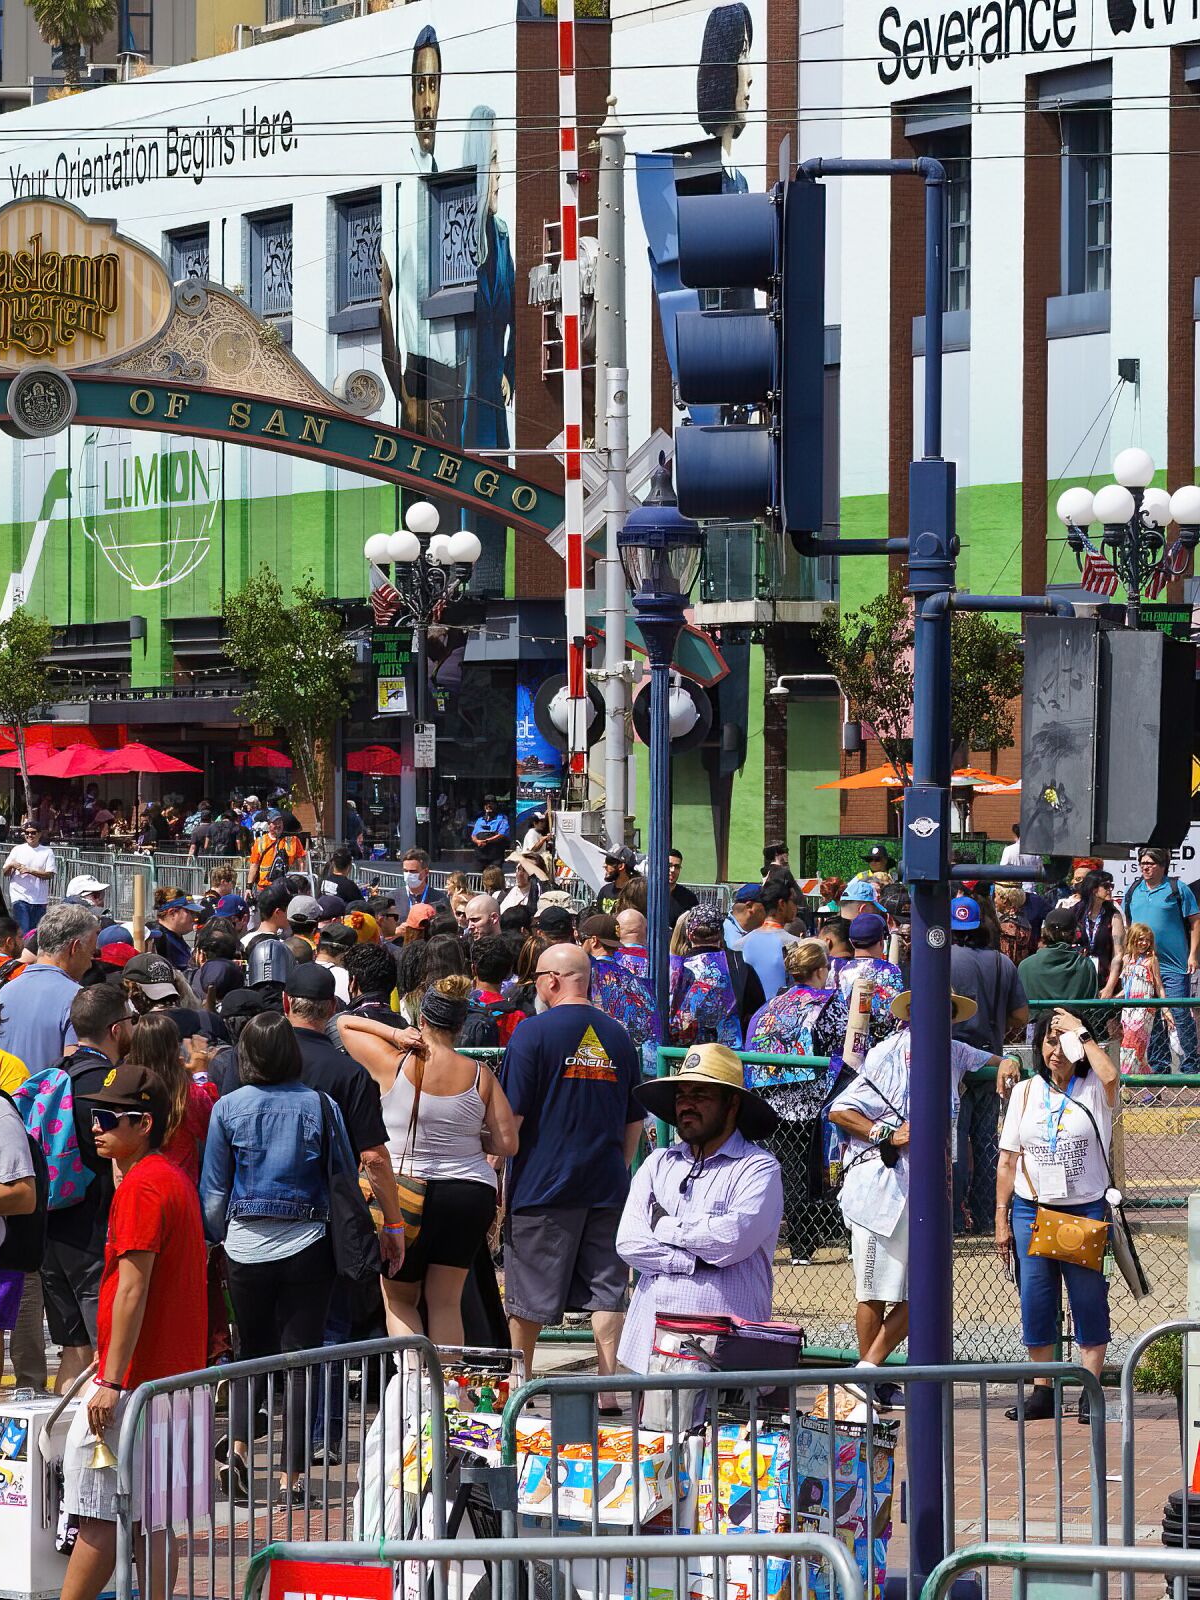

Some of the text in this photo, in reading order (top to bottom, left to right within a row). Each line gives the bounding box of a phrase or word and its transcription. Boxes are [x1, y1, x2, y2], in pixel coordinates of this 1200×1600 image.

[878, 0, 1077, 84] Severance
[9, 163, 50, 198] Your
[55, 135, 160, 199] Orientation
[166, 117, 236, 184] Begins
[129, 389, 190, 420] OF
[228, 403, 332, 445] SAN
[370, 433, 538, 512] DIEGO
